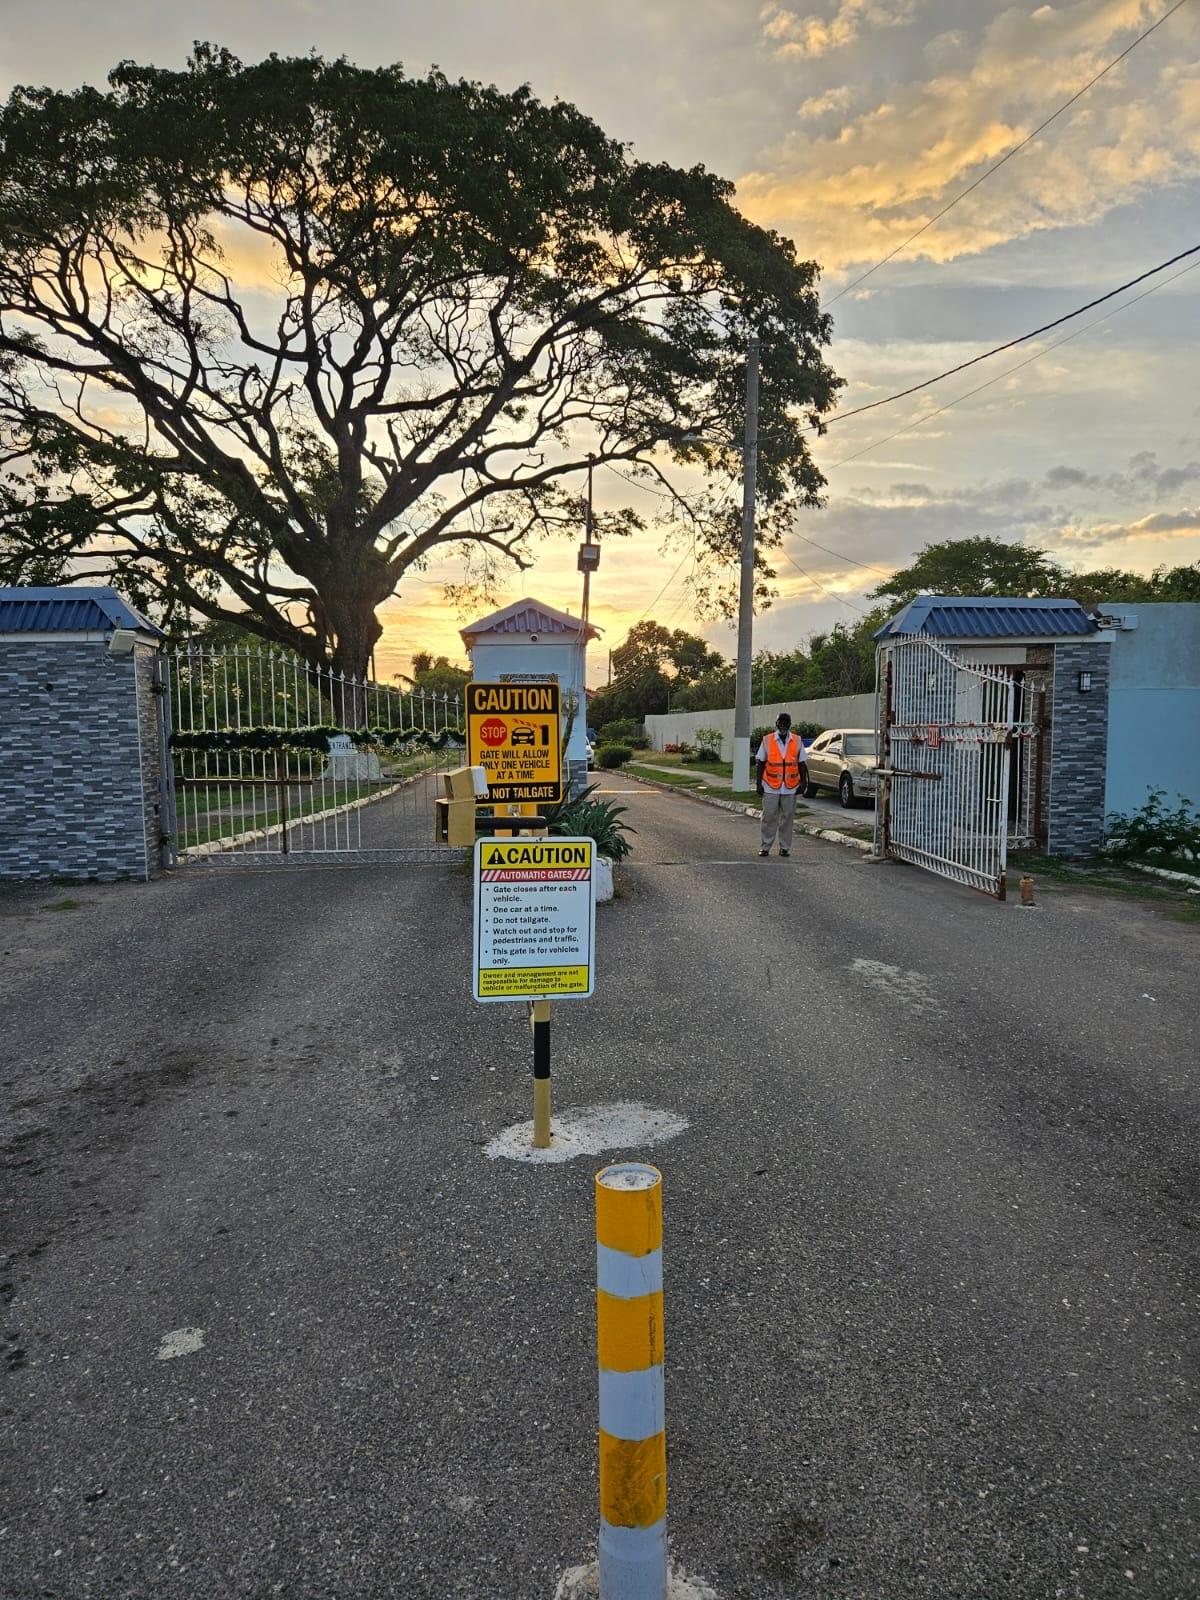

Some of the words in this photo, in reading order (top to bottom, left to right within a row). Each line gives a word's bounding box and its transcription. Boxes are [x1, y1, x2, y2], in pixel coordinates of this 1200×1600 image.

[475, 689, 552, 710] CAUTION
[481, 726, 506, 738] STOP
[480, 750, 500, 759] GATE
[502, 750, 521, 759] WILL
[523, 749, 550, 759] ALLOW
[480, 760, 500, 770] ONLY
[501, 760, 518, 770] ONE
[519, 760, 551, 769] VEHICLE
[496, 771, 506, 780] AT
[508, 770, 514, 779] A
[515, 770, 535, 779] TIME
[492, 787, 511, 799] NOT
[513, 786, 554, 798] TAILGATE
[506, 847, 586, 864] CAUTION
[499, 871, 546, 880] AUTOMATIC
[547, 870, 573, 879] GATES
[493, 895, 523, 903] vehicle.
[520, 916, 551, 924] tailgate.
[548, 926, 565, 935] stop
[492, 936, 537, 946] pedestrians
[554, 935, 579, 943] traffic.
[509, 947, 526, 956] gate
[537, 946, 548, 954] for
[549, 946, 579, 954] vehicles
[492, 957, 510, 966] only.
